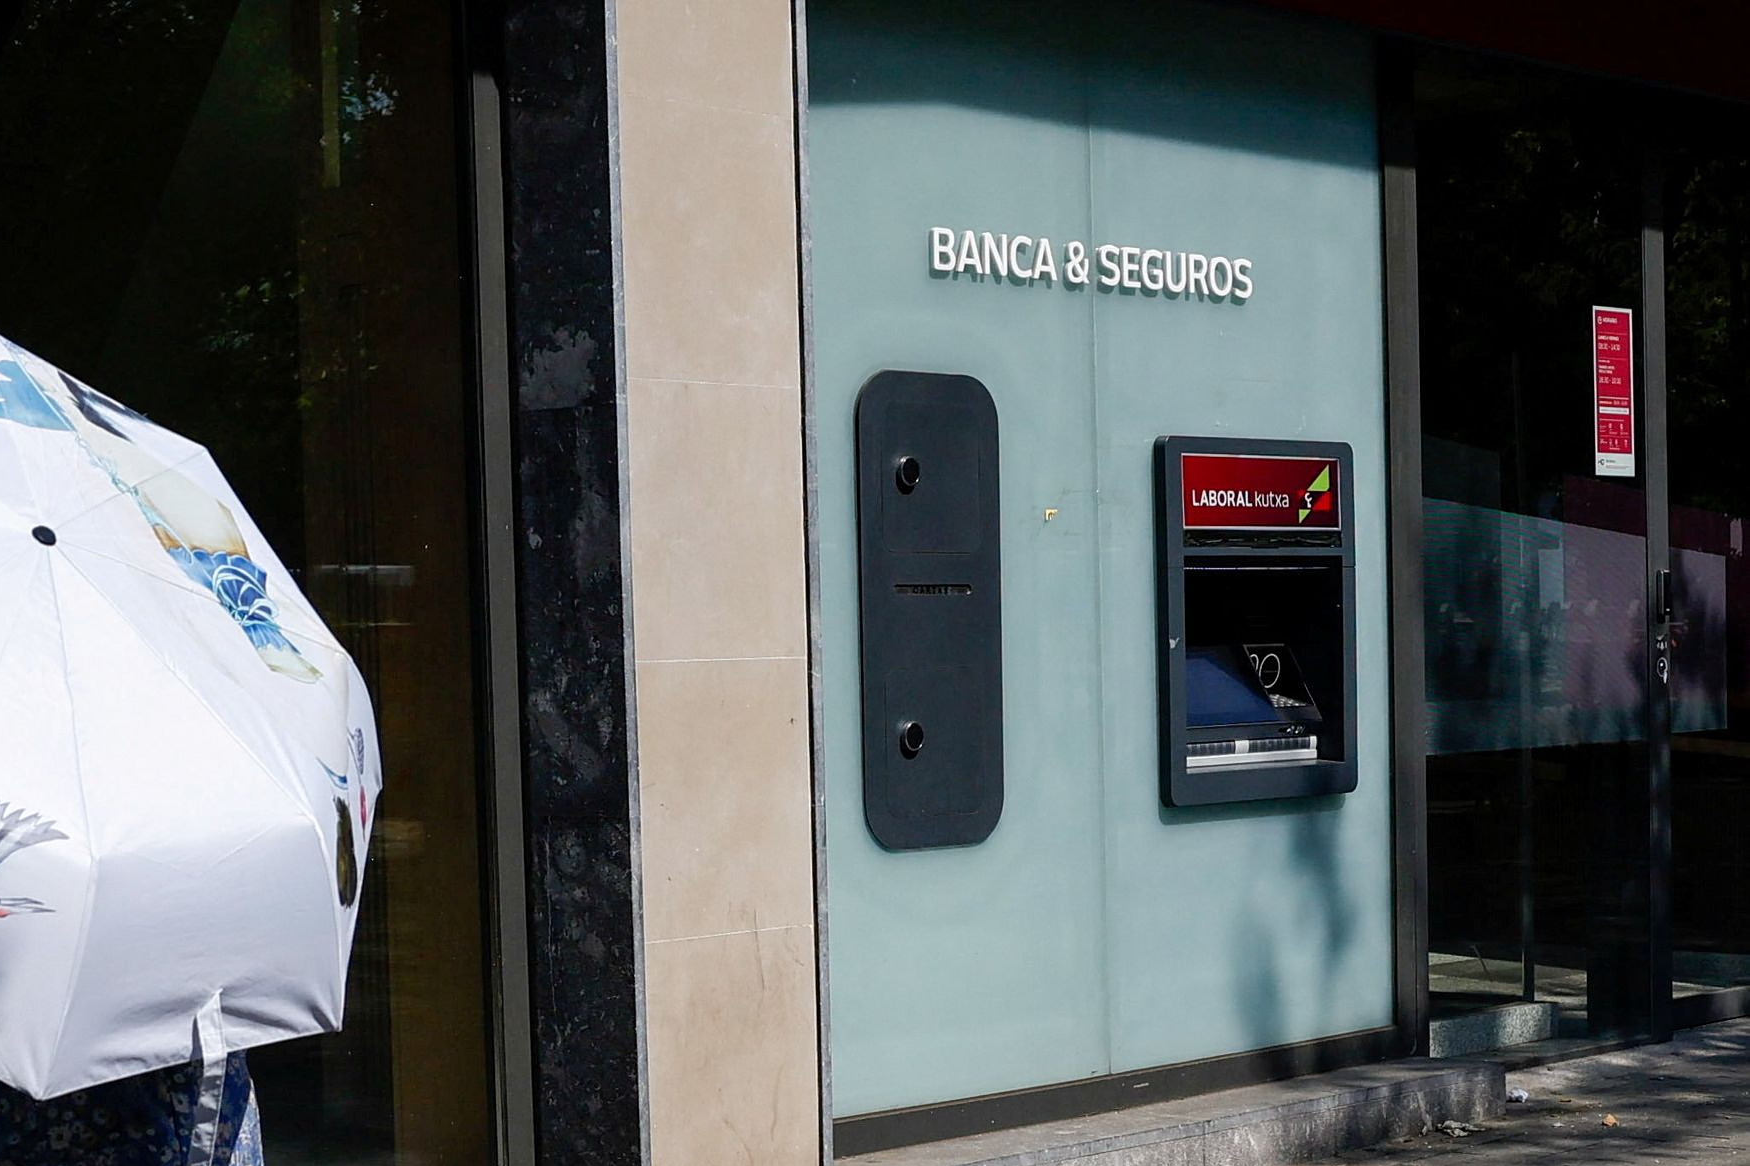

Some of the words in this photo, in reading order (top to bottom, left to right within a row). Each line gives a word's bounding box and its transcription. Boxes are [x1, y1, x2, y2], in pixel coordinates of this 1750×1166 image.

[929, 226, 1058, 283] BANCA
[1064, 240, 1091, 285] &
[1097, 243, 1254, 299] SEGUROS
[1192, 489, 1253, 508] LABORAL
[1254, 490, 1290, 508] kutxa
